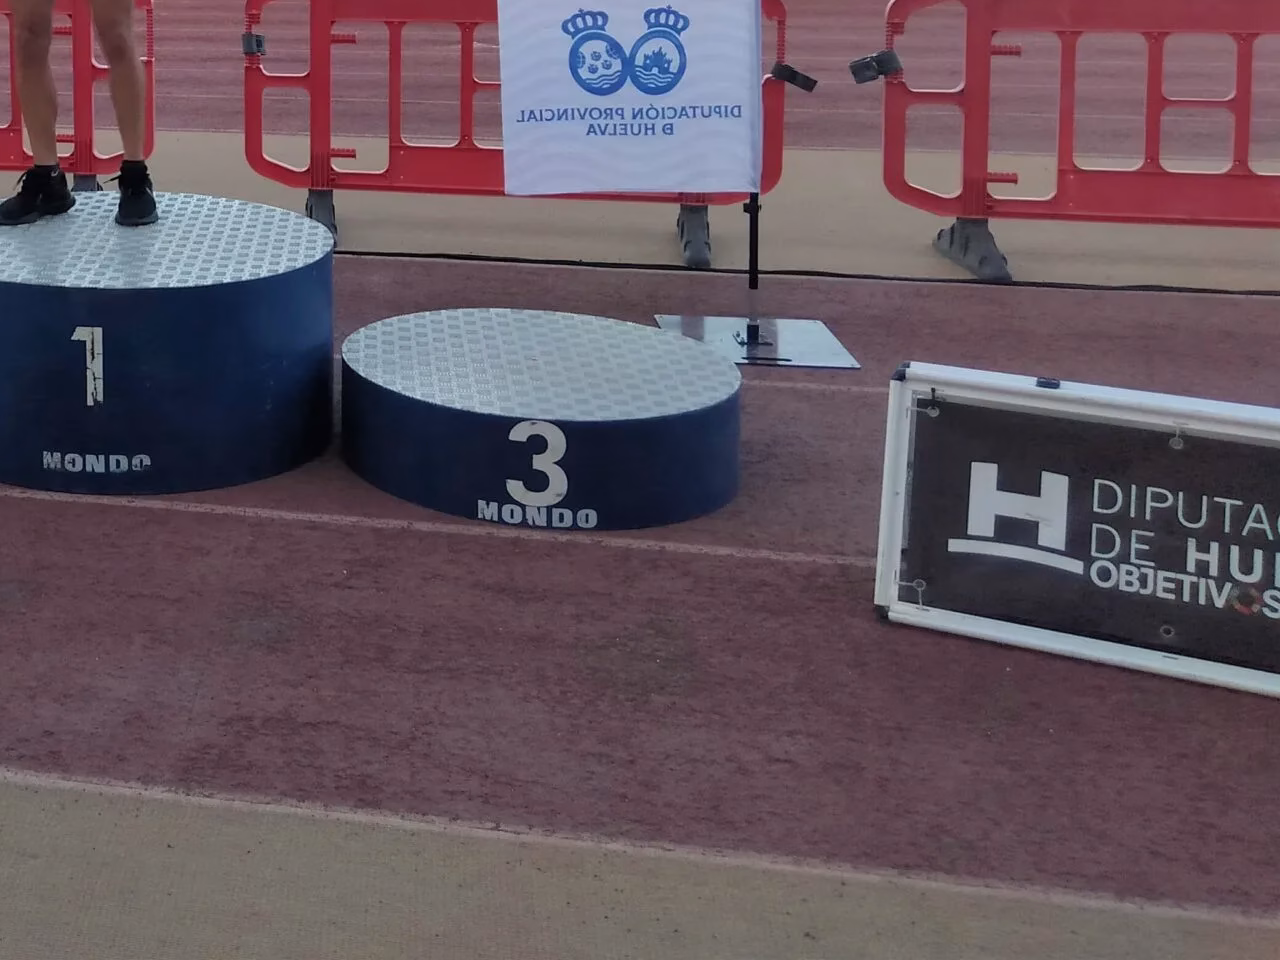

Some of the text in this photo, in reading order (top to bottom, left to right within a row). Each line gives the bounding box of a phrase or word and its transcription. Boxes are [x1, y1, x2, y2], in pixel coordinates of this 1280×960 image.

[70, 326, 104, 406] 1
[42, 450, 152, 474] MONDO
[505, 420, 569, 507] 3
[477, 499, 598, 529] MONDO
[1092, 478, 1280, 541] DIPUTA
[1090, 522, 1280, 589] DE HU
